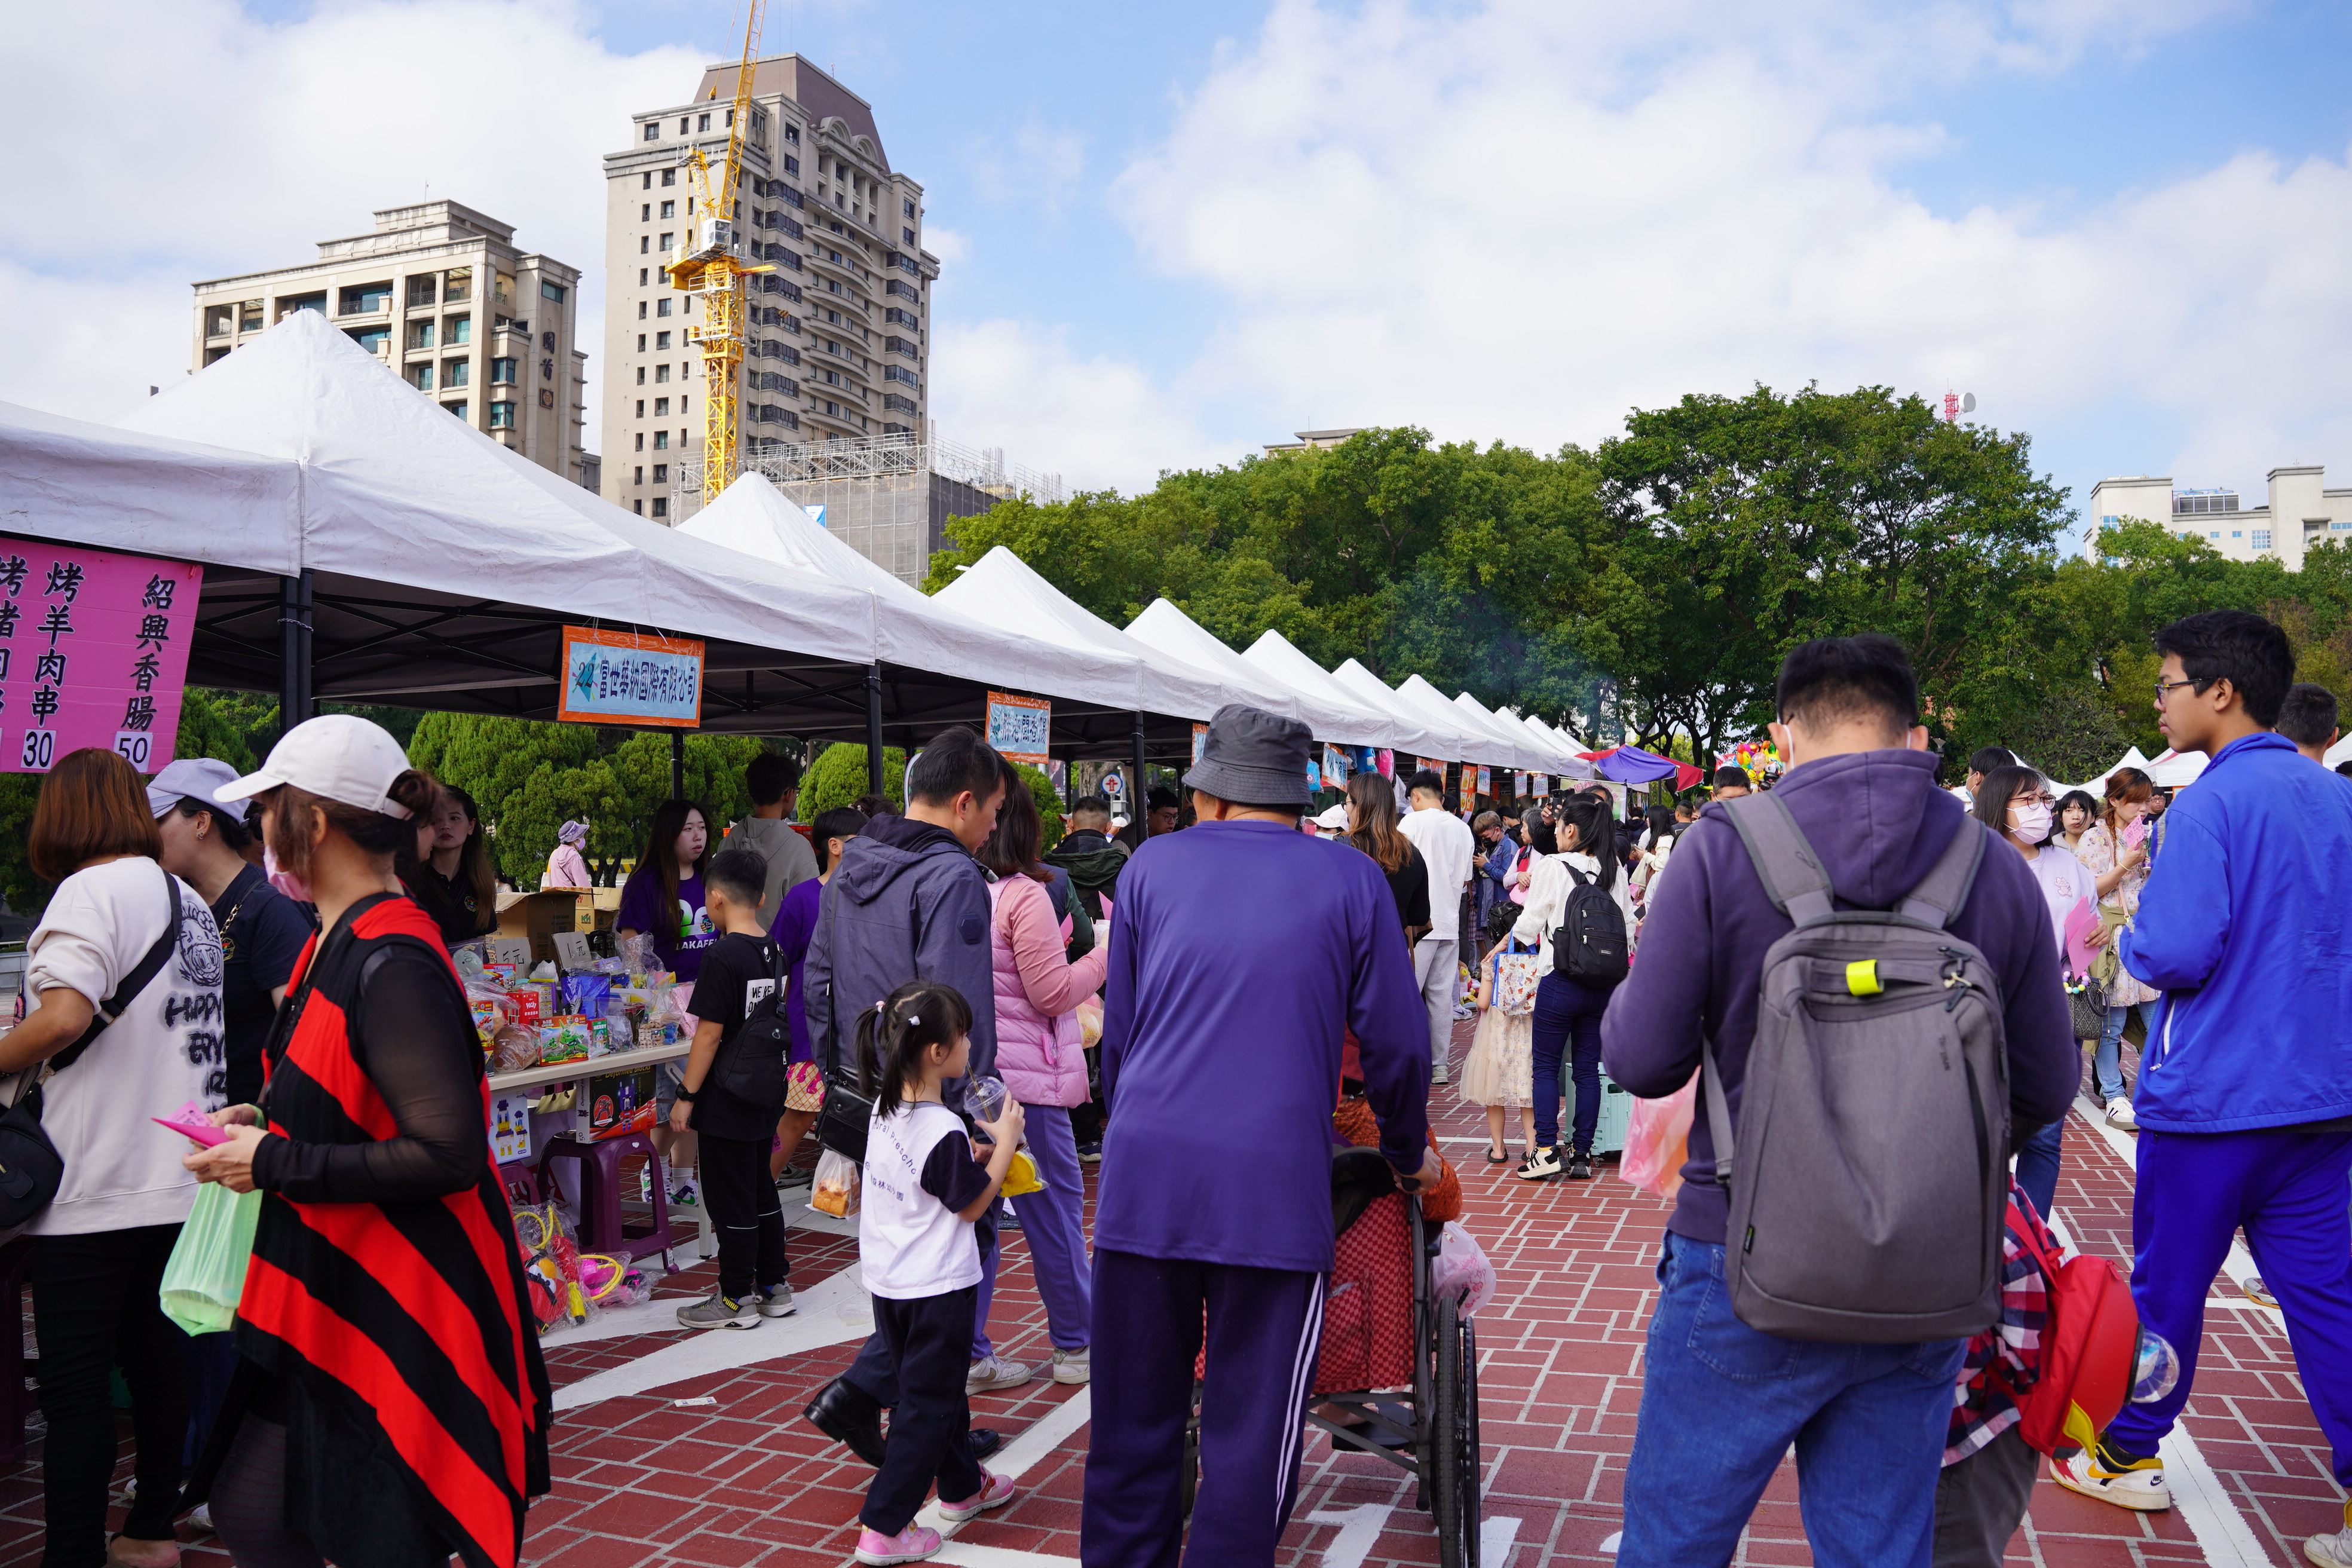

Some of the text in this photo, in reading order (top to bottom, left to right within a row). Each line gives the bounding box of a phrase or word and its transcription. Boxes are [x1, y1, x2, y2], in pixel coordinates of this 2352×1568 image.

[31, 561, 84, 728] 烤羊肉串
[121, 574, 176, 731] 紹興香腸
[576, 662, 595, 688] 22
[23, 731, 52, 767] 30
[118, 737, 148, 764] 50
[722, 1296, 739, 1311] PUMA
